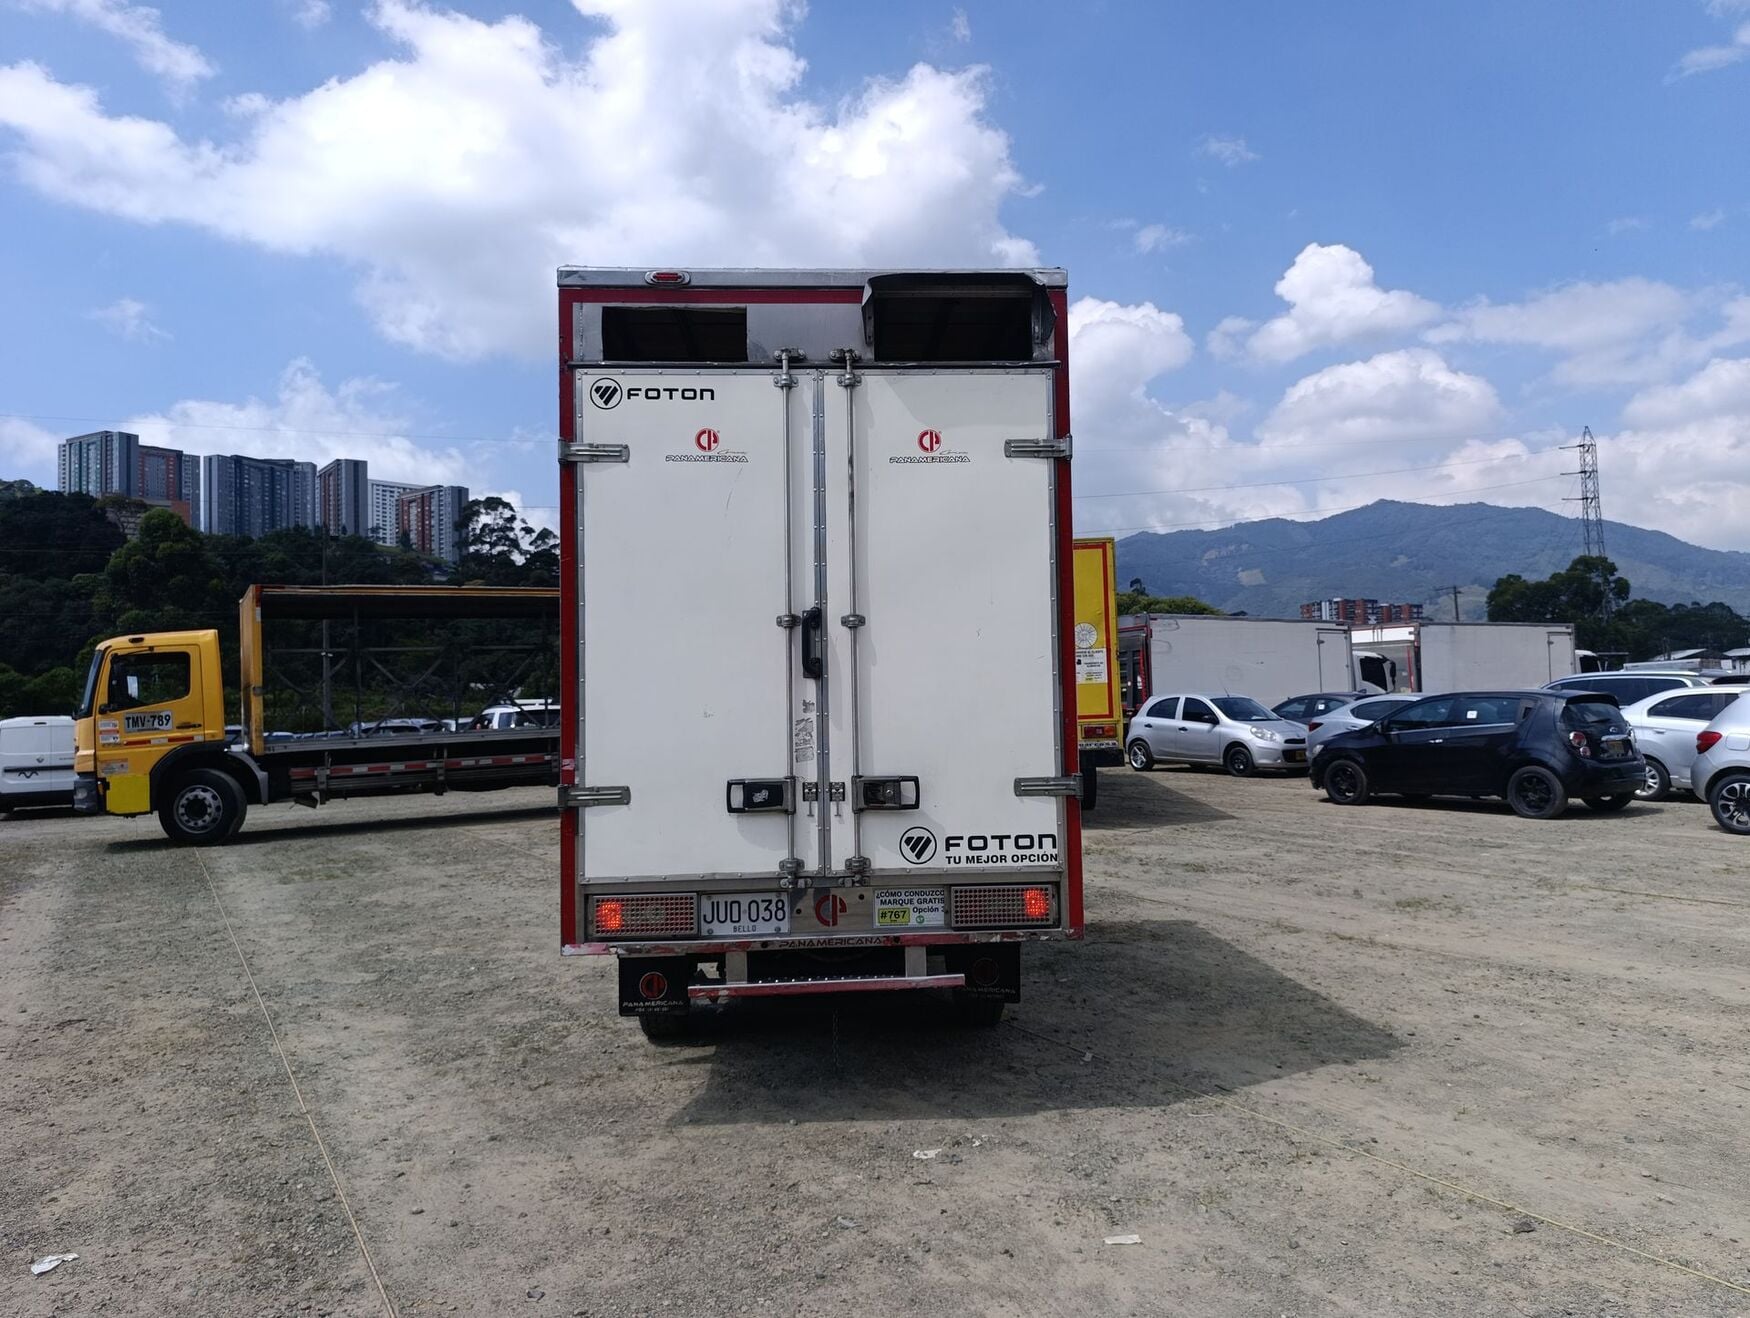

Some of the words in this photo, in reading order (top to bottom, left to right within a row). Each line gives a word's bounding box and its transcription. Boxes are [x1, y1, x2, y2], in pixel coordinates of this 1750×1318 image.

[627, 388, 715, 400] FOTON
[665, 455, 749, 463] PANAMERICANA
[889, 455, 971, 464] PANAMERICANA
[945, 834, 1057, 851] FOTON
[945, 855, 961, 864] TU
[966, 854, 1007, 864] MEJOR
[1011, 851, 1058, 863] OPCIÓN
[880, 898, 914, 906] MARQUE
[917, 897, 945, 905] GRATIS
[880, 910, 907, 919] #767
[912, 906, 939, 914] Opción
[733, 925, 757, 933] BELLO
[779, 938, 881, 948] PANAMERICANA
